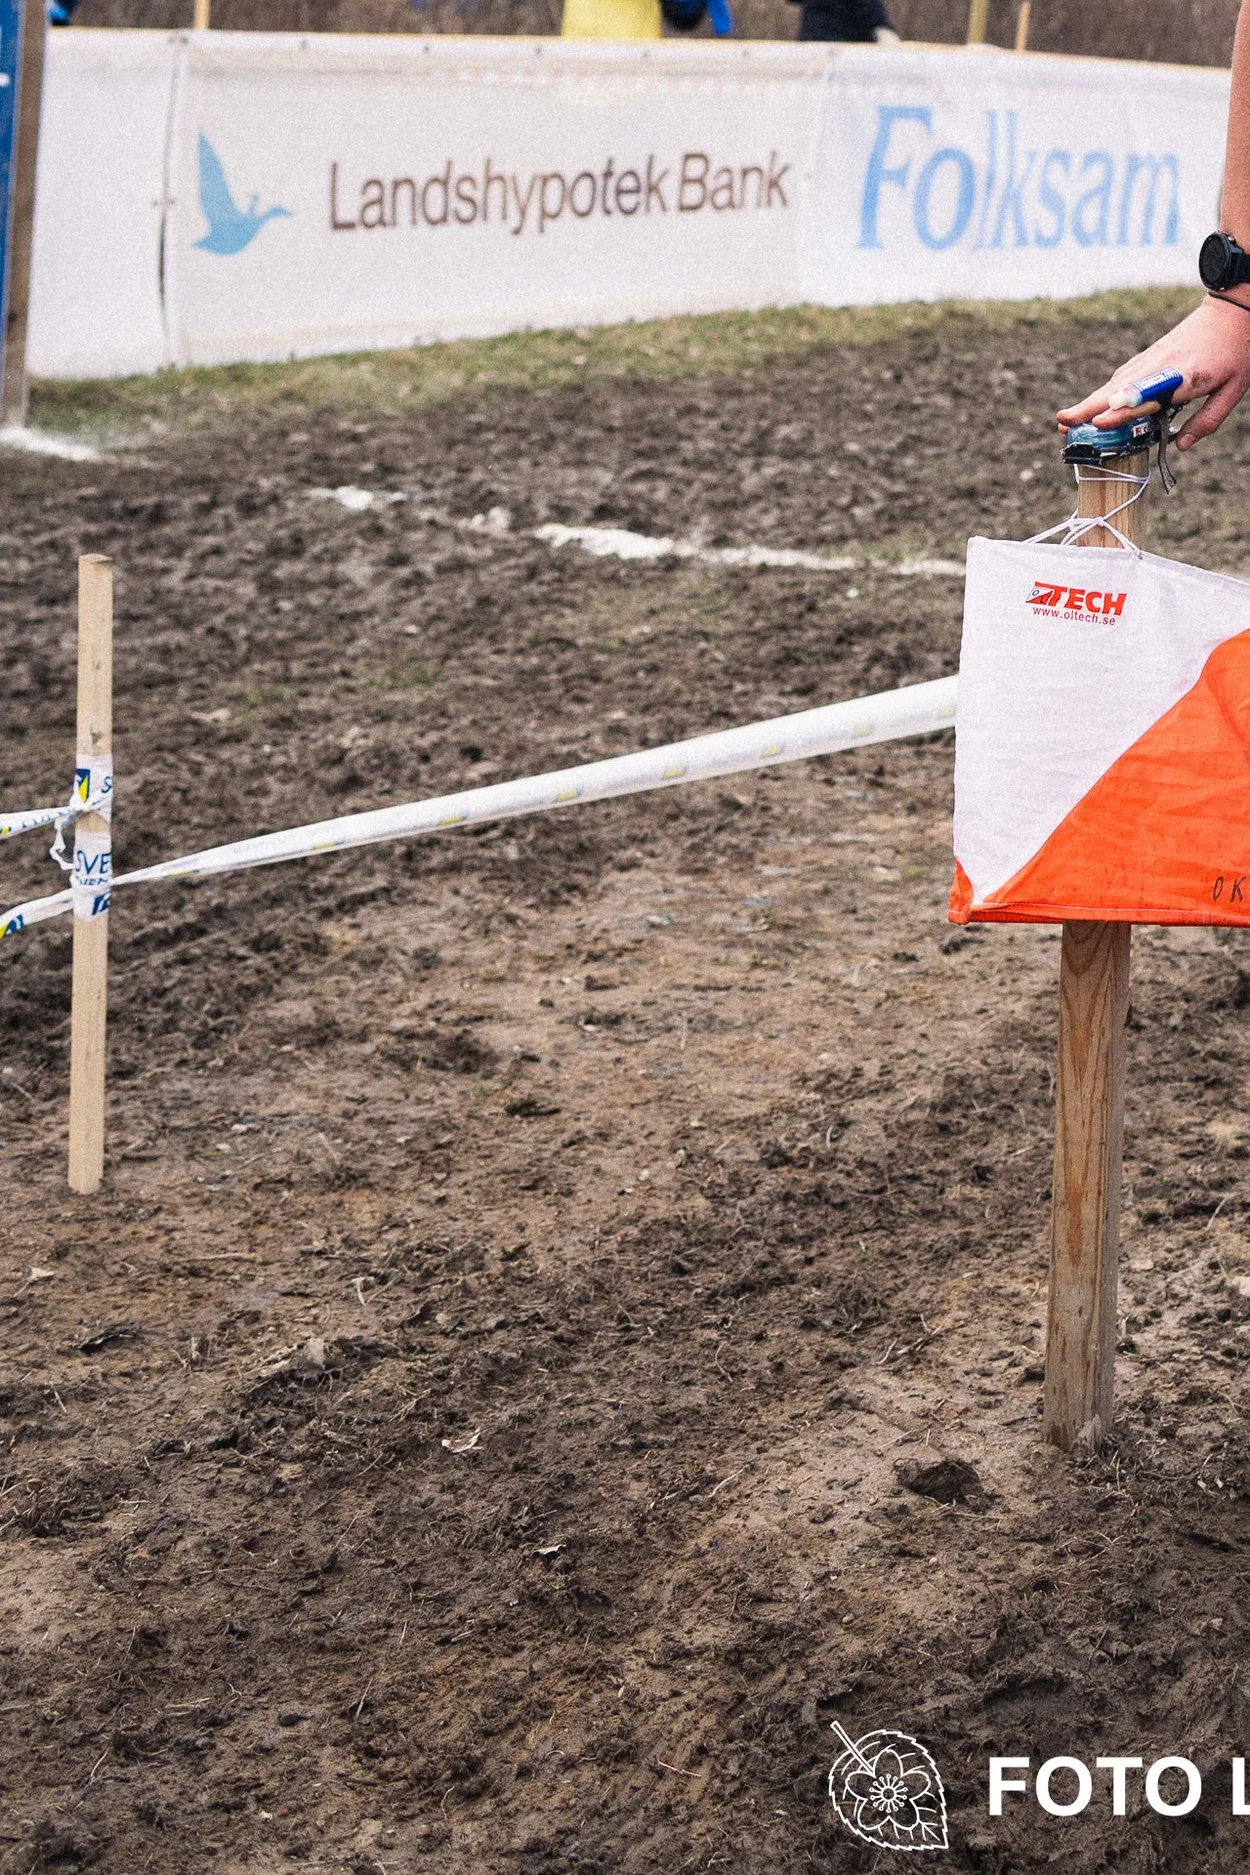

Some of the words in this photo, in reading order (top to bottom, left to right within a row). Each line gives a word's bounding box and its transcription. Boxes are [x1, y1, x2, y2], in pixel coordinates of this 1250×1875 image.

[330, 153, 669, 236] Landshypotek
[678, 150, 792, 214] Bank
[856, 105, 1180, 252] Folksam
[1033, 607, 1117, 626] www.oltech.se
